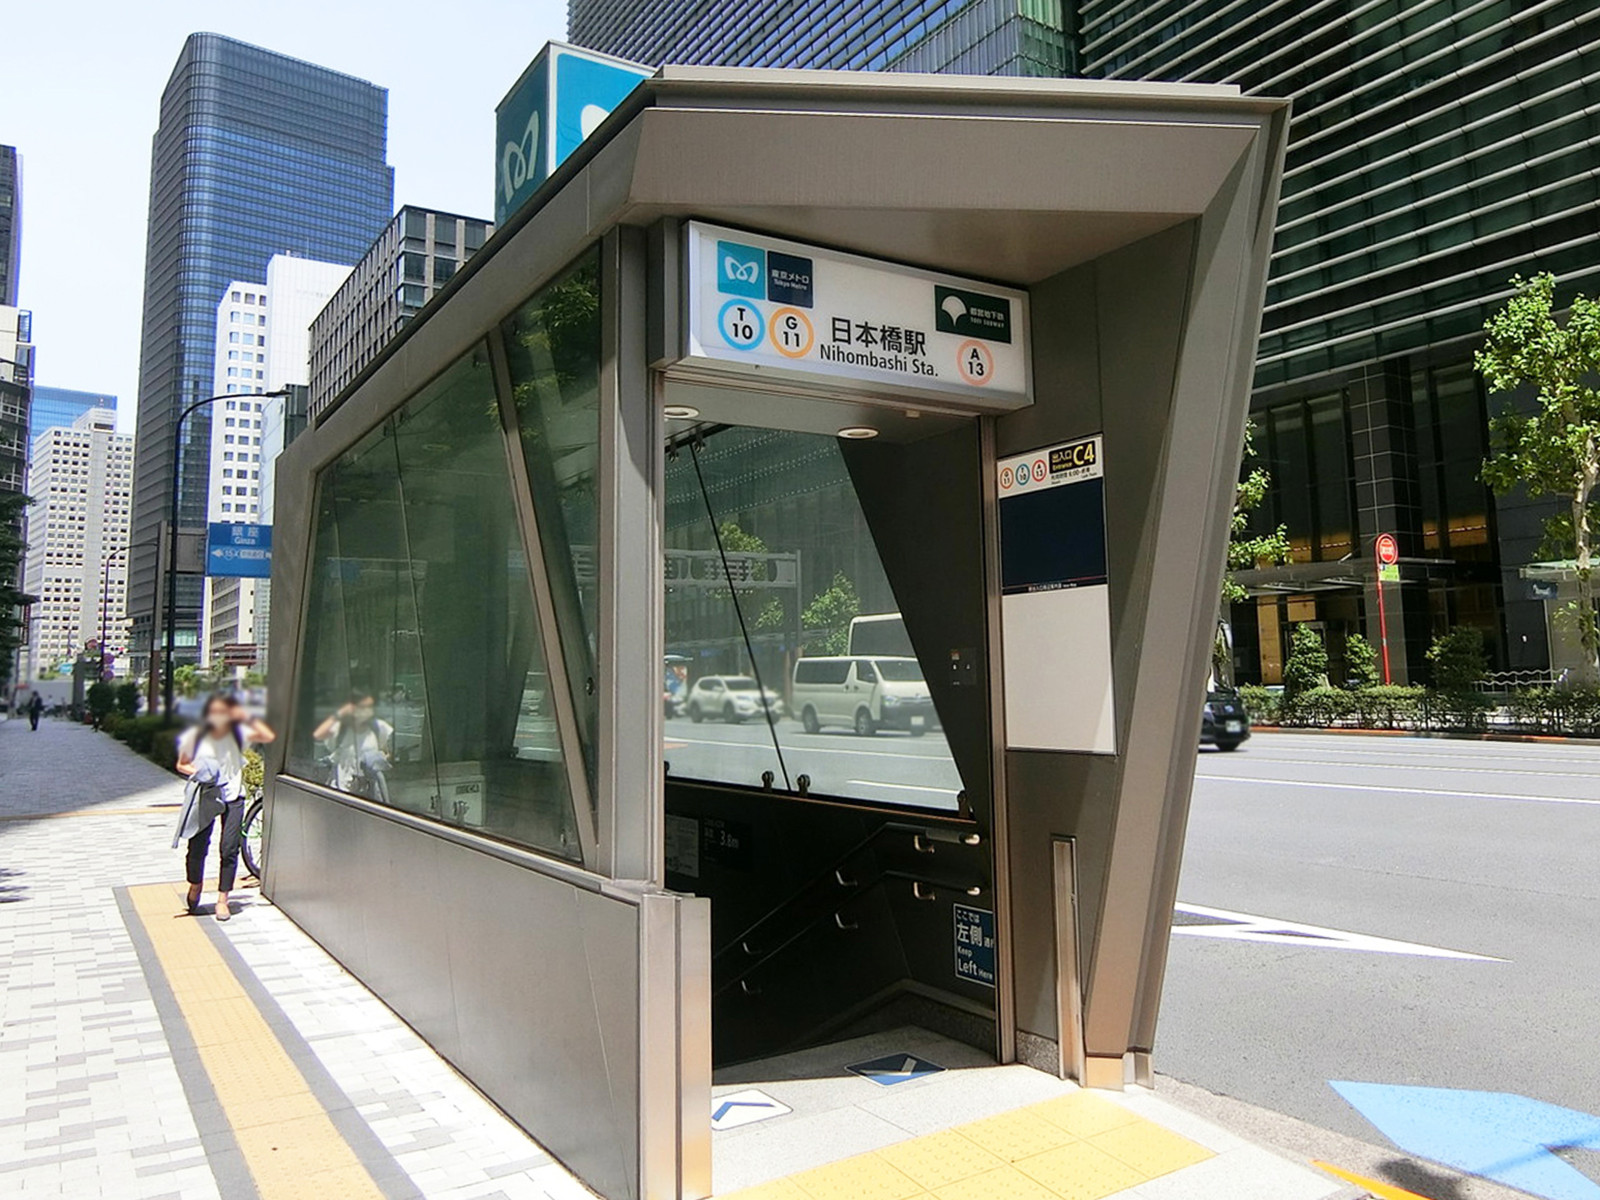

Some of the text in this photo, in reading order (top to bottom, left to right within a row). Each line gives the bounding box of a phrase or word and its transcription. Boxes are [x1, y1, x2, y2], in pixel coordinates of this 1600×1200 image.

[737, 307, 746, 321] T
[785, 316, 798, 330] G
[733, 323, 753, 340] 10
[783, 331, 800, 347] 11
[832, 316, 926, 356] 日本橋駅
[820, 343, 939, 377] Nihombashi Sta.
[970, 348, 980, 361] A
[968, 361, 985, 376] 13
[1073, 443, 1095, 466] C4
[234, 536, 256, 545] Ginza
[957, 946, 973, 958] Keep
[958, 959, 978, 976] Left
